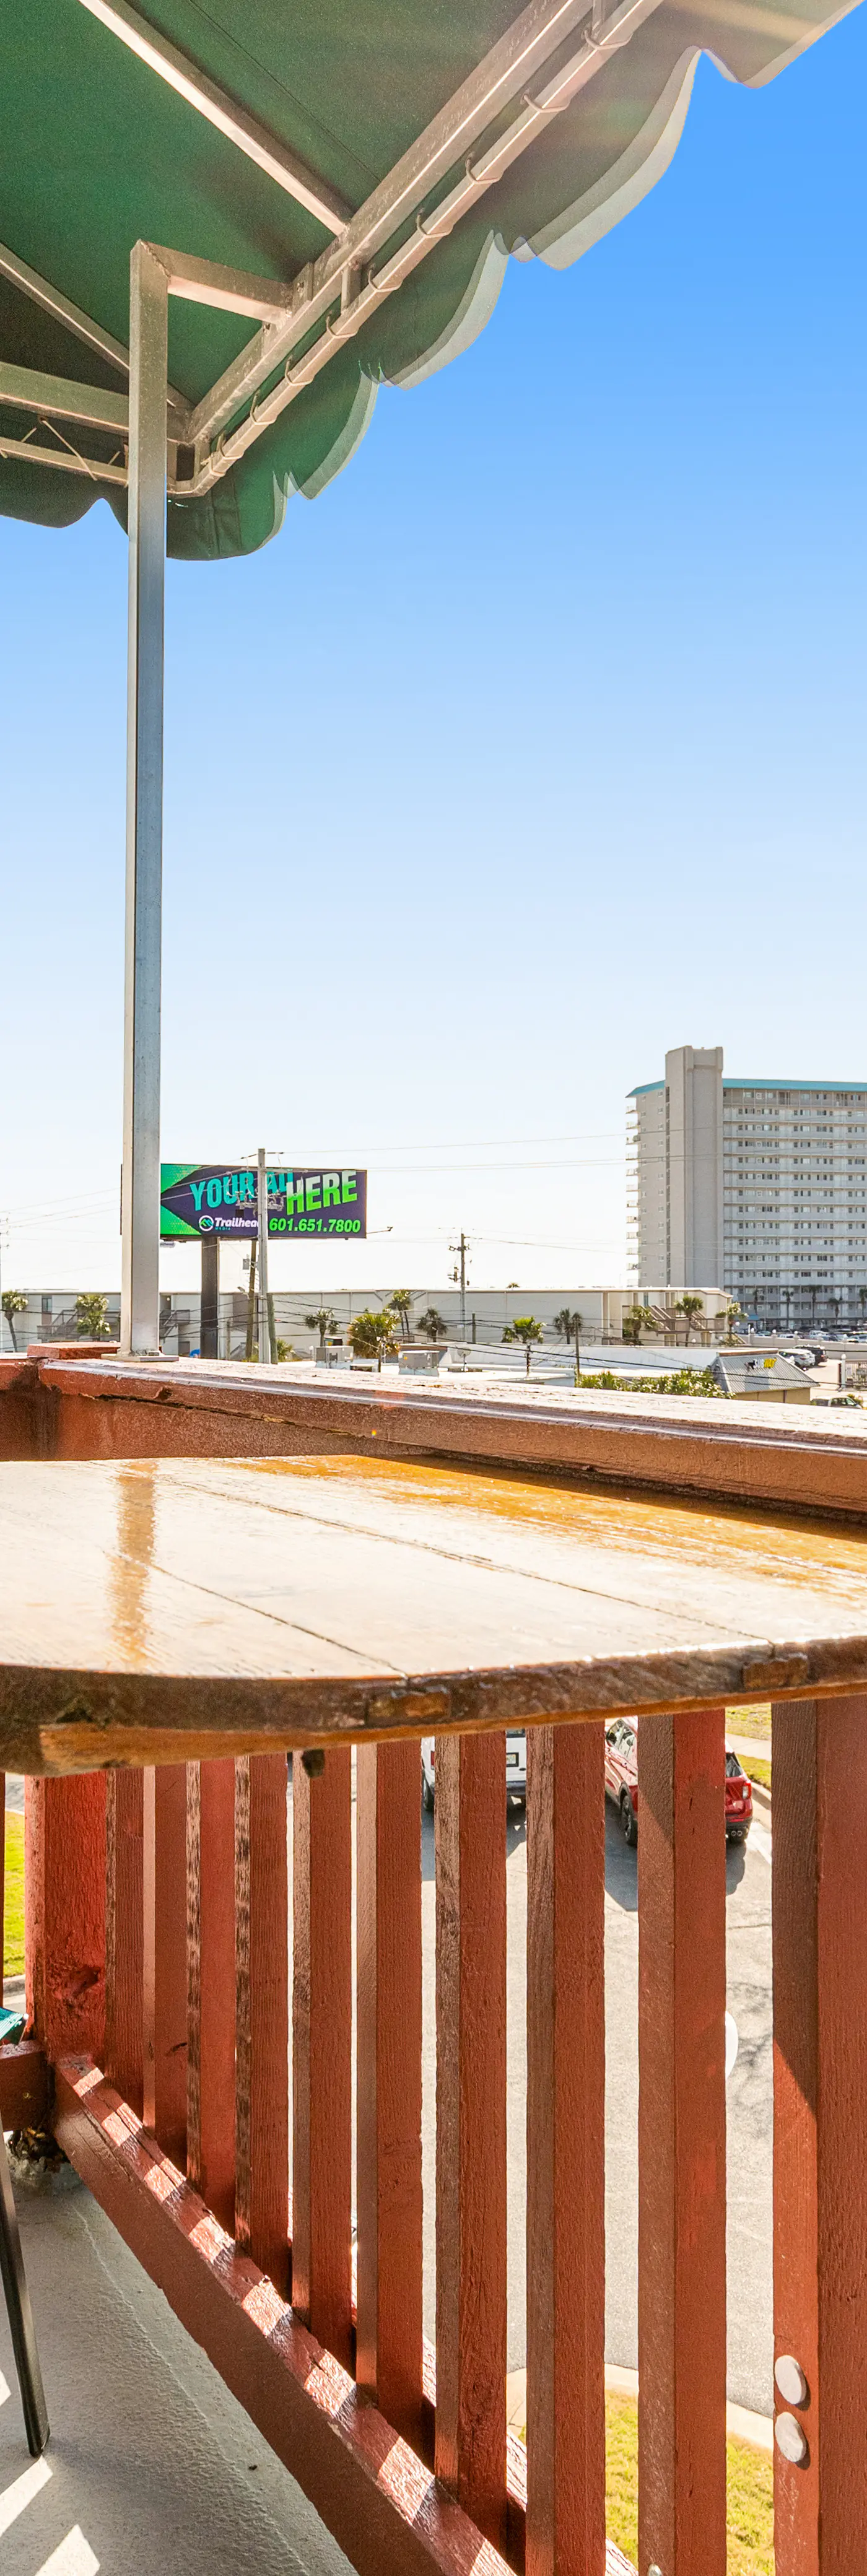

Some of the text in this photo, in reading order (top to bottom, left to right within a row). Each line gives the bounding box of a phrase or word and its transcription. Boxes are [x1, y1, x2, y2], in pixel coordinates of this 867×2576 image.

[190, 1172, 255, 1211] YOUR
[286, 1170, 357, 1216] HERE
[269, 1218, 361, 1233] 601.651.7800
